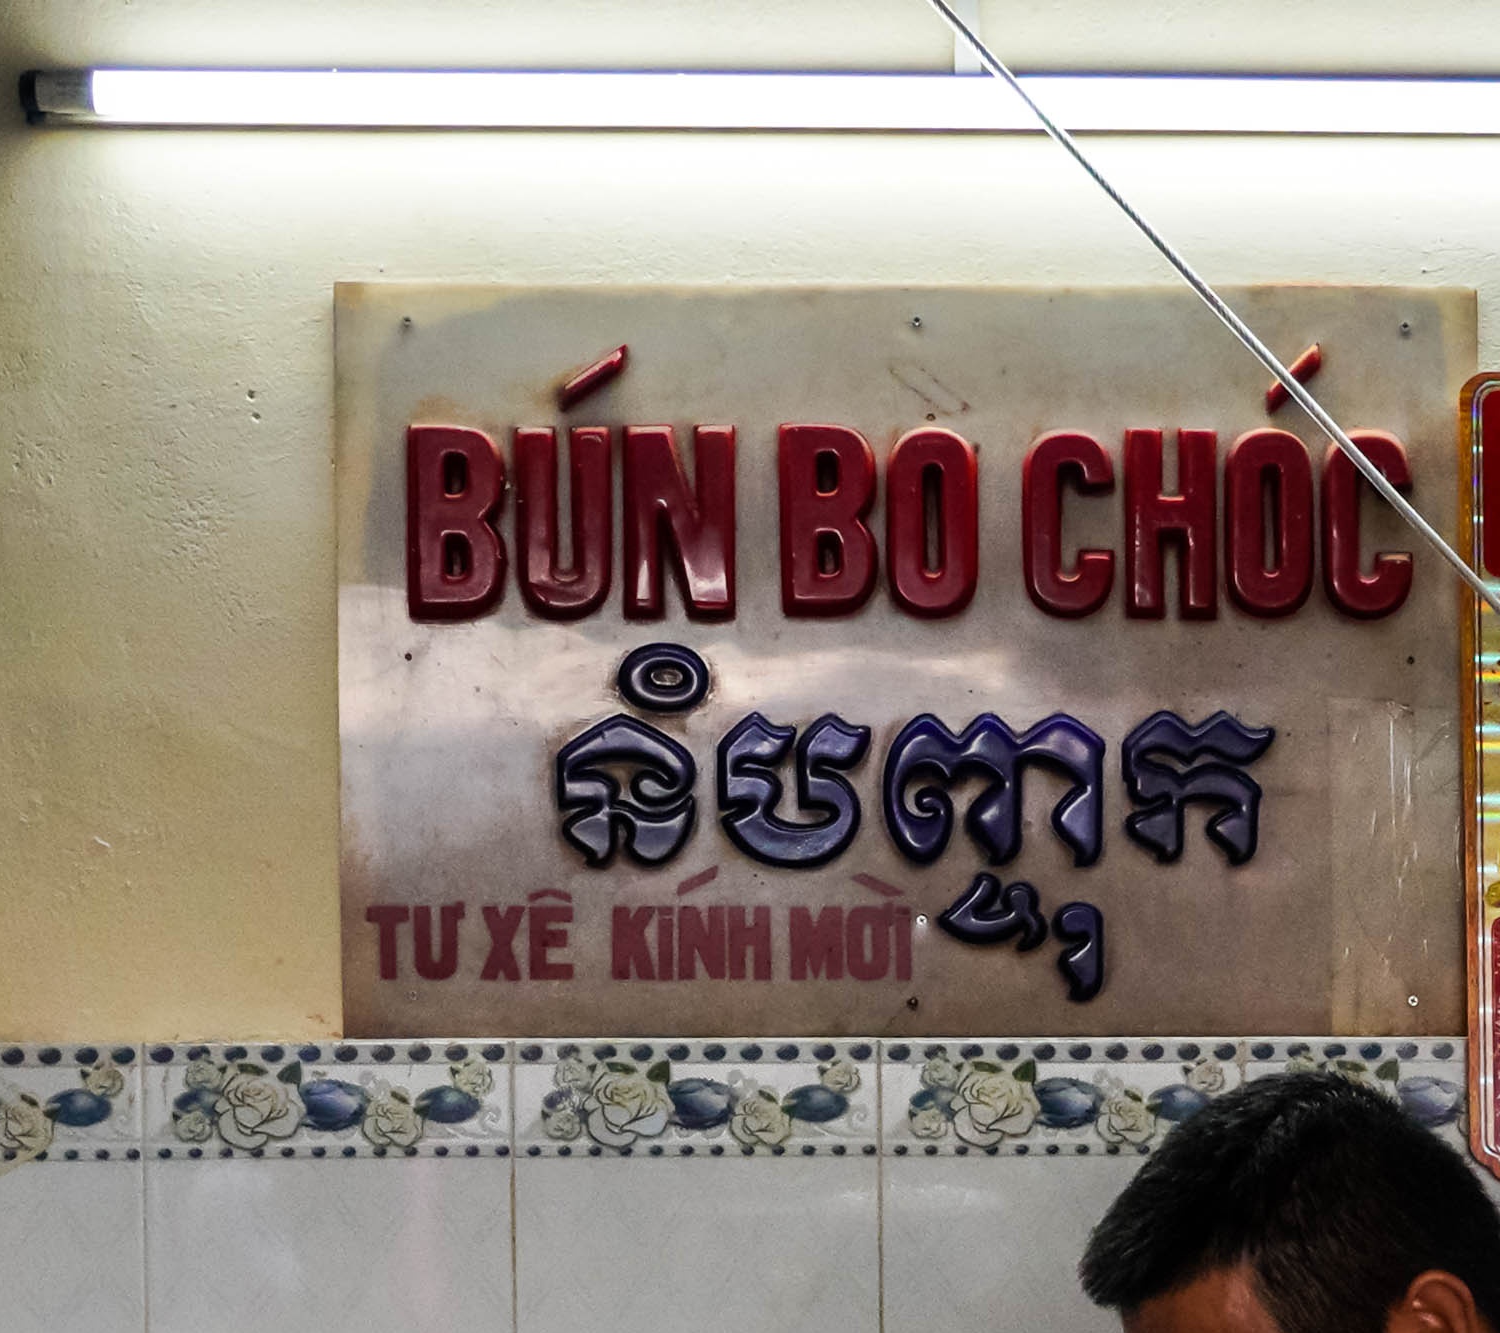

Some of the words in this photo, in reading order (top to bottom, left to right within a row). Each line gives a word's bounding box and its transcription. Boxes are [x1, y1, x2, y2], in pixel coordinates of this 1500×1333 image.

[406, 344, 737, 622] BÚN
[778, 422, 979, 619] BO
[1021, 342, 1414, 620] CHÓC
[366, 901, 466, 981] TƯ
[480, 889, 574, 980] XÊ
[611, 865, 772, 981] KÍNH
[790, 872, 913, 981] MỜI
